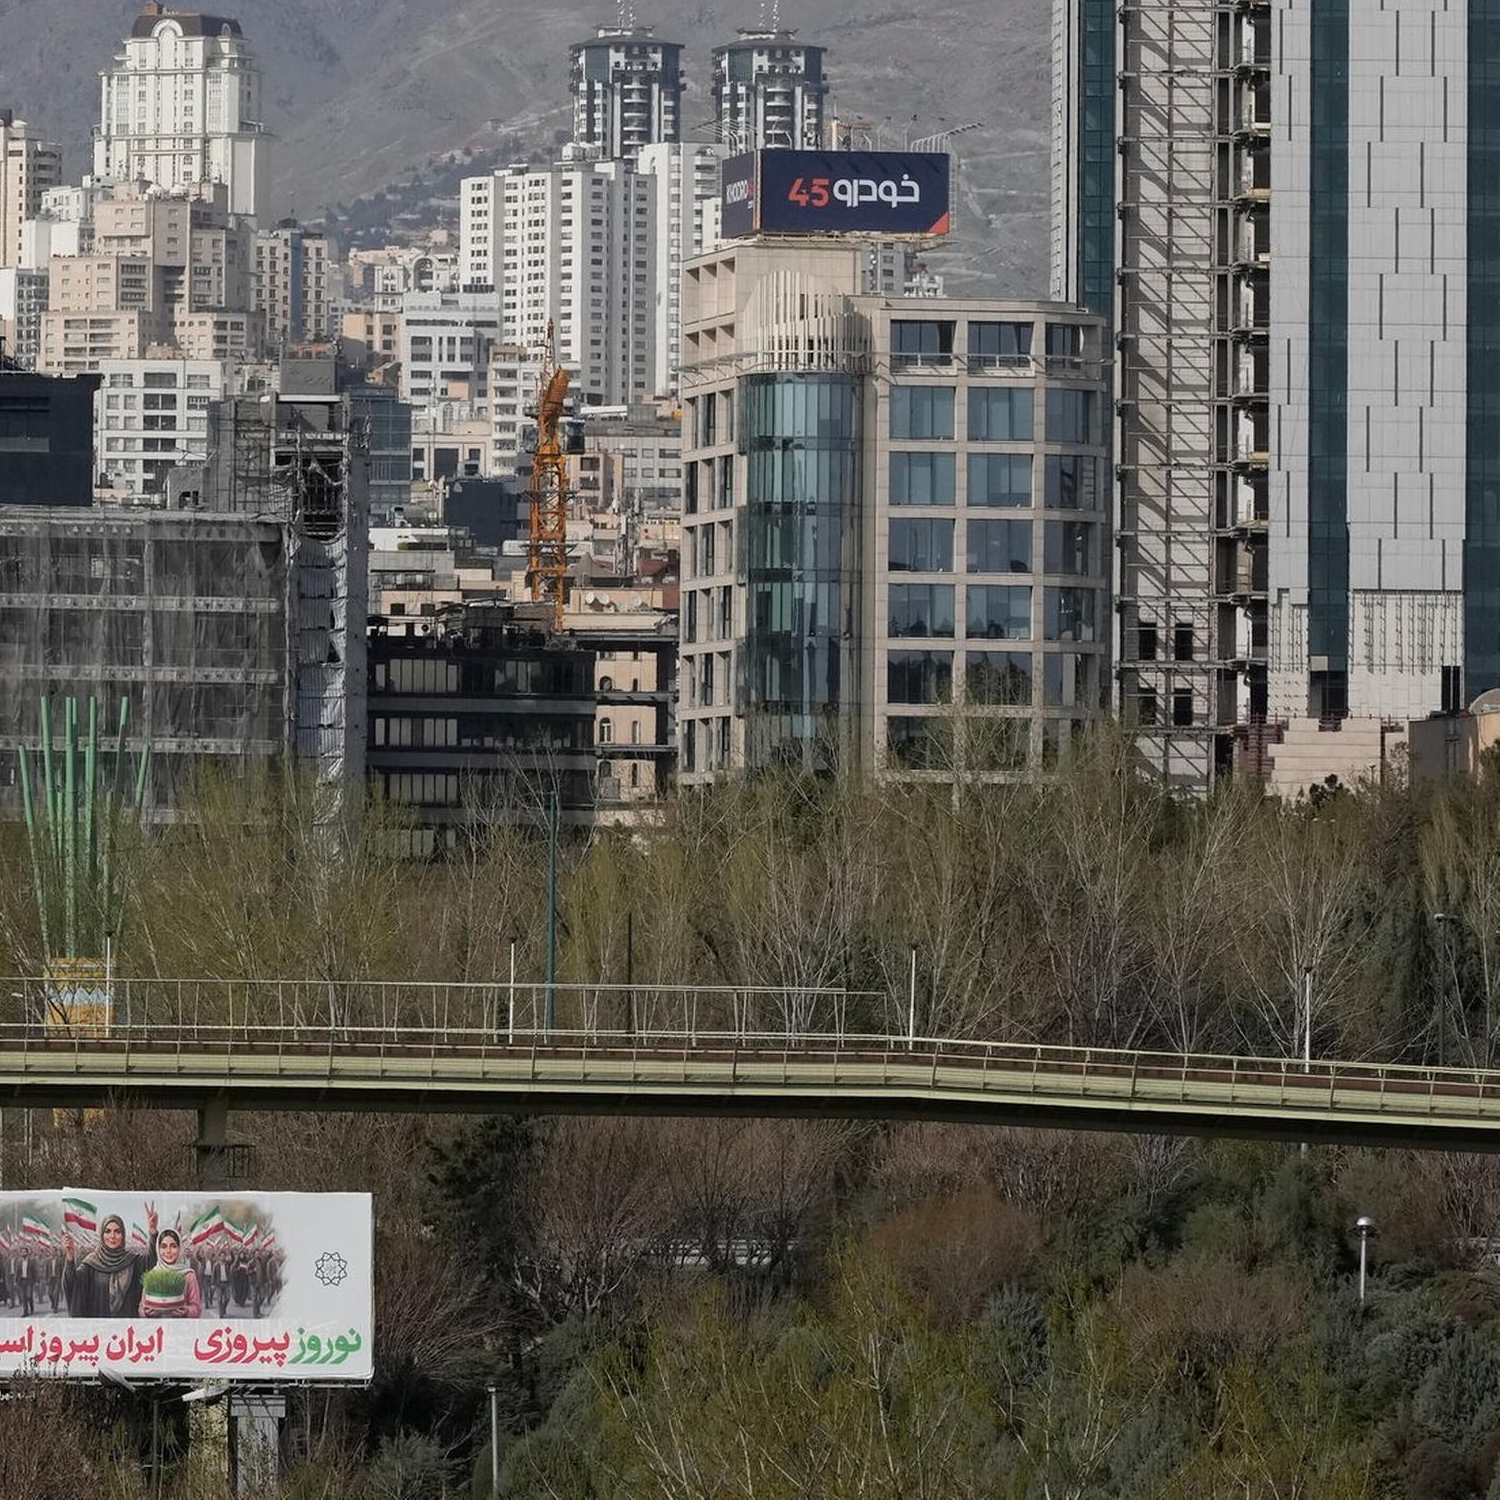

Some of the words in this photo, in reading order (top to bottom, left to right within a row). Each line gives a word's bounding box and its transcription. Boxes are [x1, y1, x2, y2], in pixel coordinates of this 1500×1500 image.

[788, 178, 830, 208] 45
[833, 174, 920, 208] خودرو
[34, 1331, 100, 1367] پیروز
[105, 1325, 165, 1363] ایران
[194, 1326, 290, 1367] پیروزی
[288, 1327, 362, 1364] نوروز
